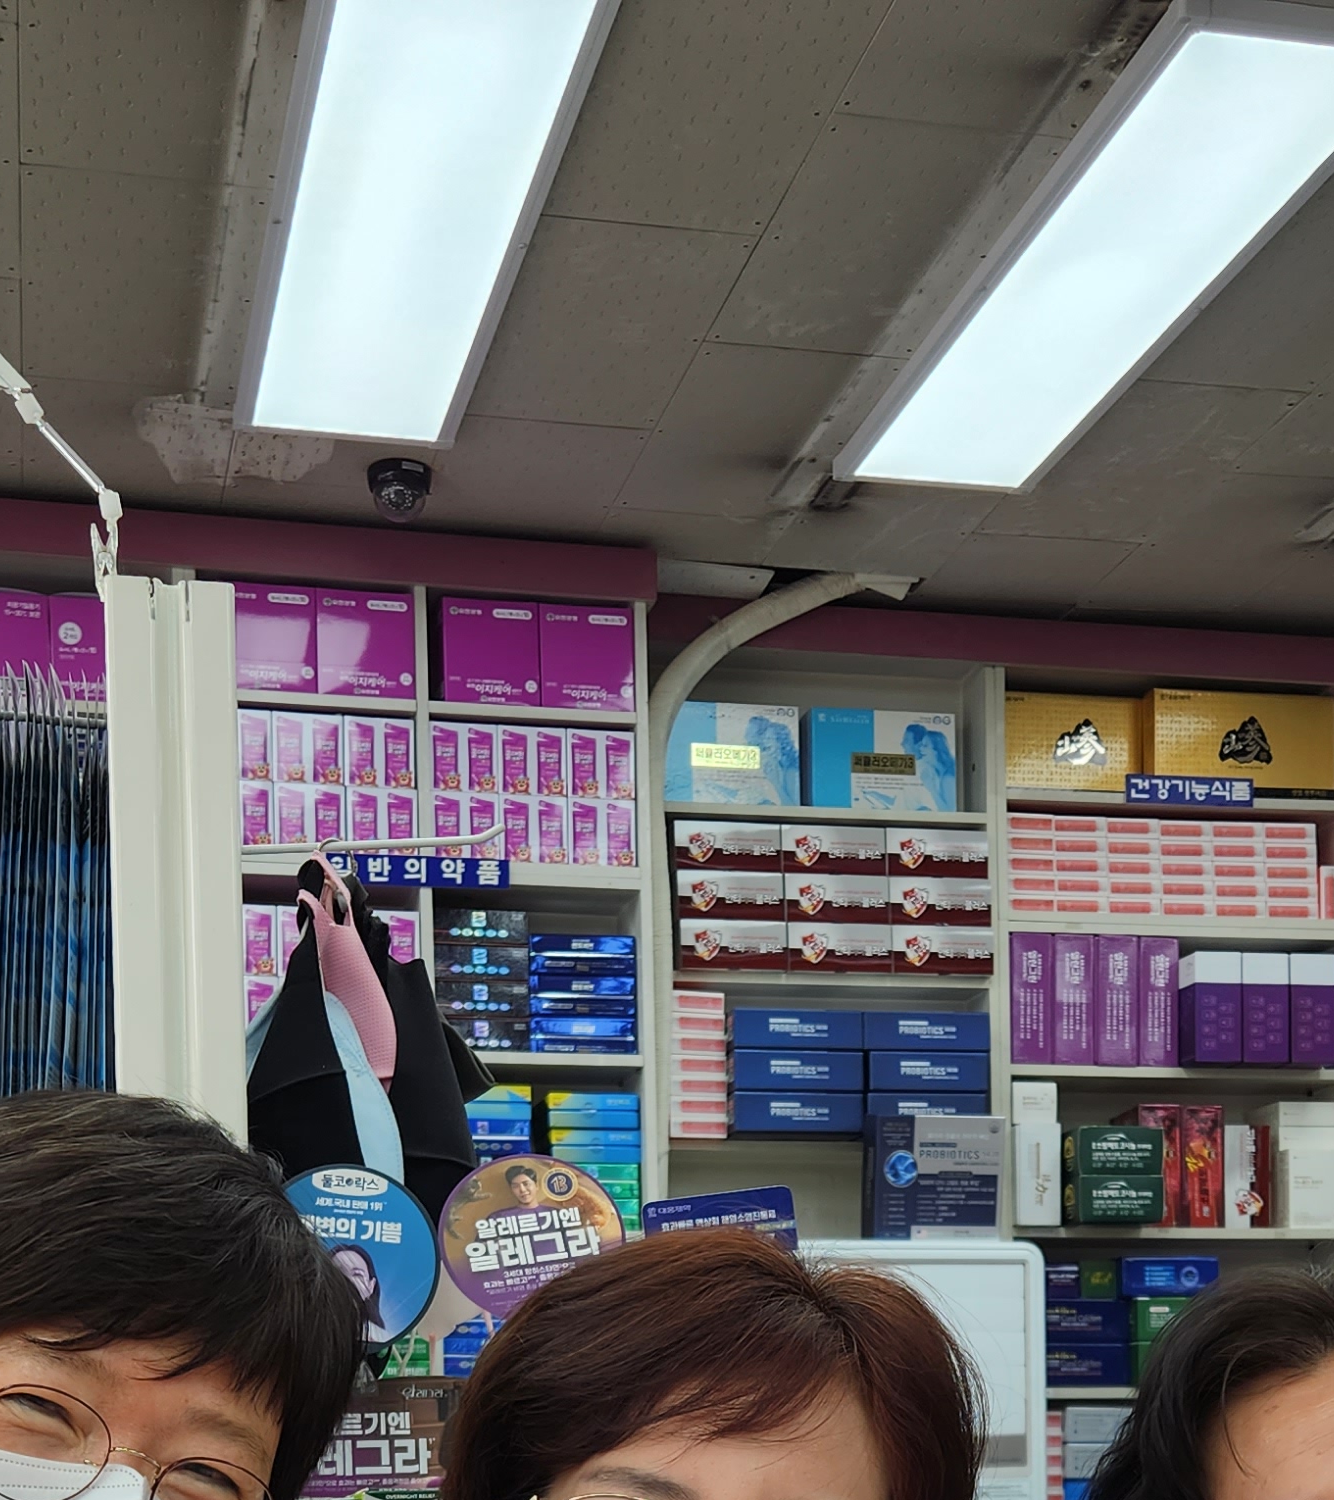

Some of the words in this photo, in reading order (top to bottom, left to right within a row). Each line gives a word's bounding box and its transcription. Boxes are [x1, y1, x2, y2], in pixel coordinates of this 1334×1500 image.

[1130, 778, 1251, 800] 건강기능식품
[919, 1150, 979, 1160] PROBIOTICS
[321, 1174, 380, 1191] 둘코락스
[361, 1221, 402, 1243] 기쁨
[475, 1208, 581, 1238] 알레르기엔
[465, 1228, 601, 1272] 알레그라
[318, 1437, 431, 1476] 레그라
